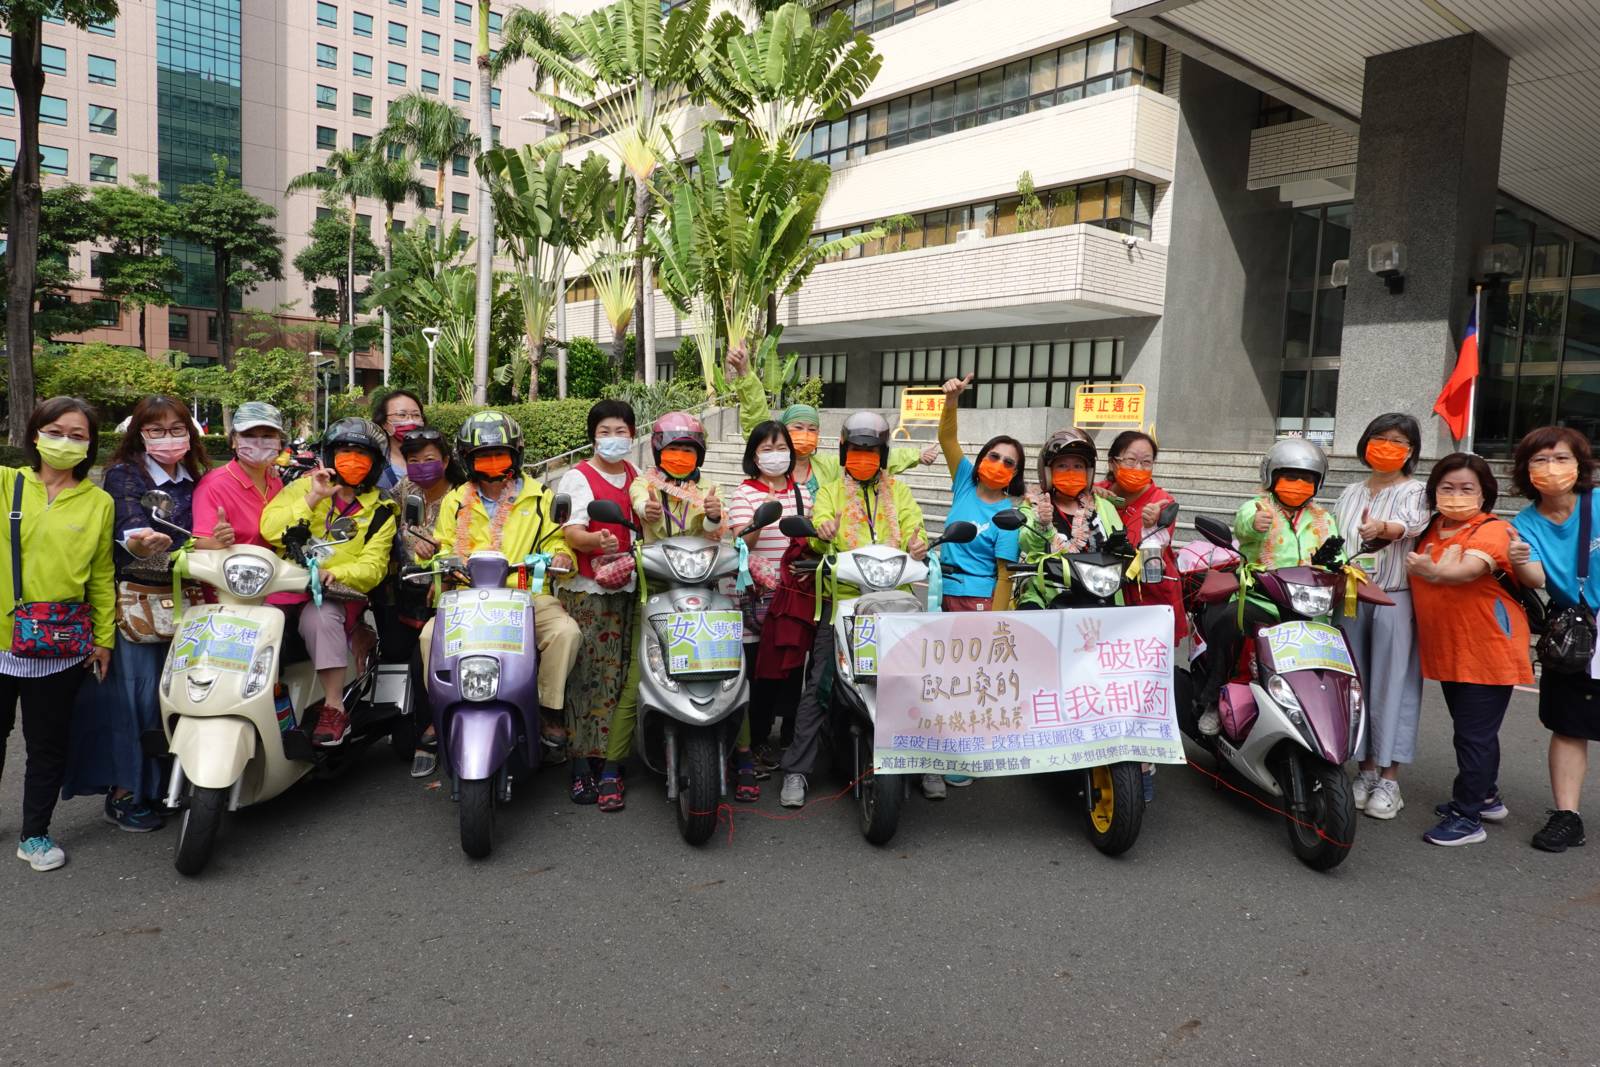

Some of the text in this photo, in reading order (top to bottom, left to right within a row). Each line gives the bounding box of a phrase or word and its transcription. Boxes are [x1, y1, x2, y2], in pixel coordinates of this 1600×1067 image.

[1082, 397, 1140, 413] 禁止通行
[176, 614, 258, 648] 女人夢想
[446, 601, 524, 634] 女人夢想
[667, 612, 742, 647] 女人夢想
[855, 619, 877, 648] 女
[920, 621, 1019, 668] 1000歲
[1096, 636, 1169, 671] 破除
[920, 666, 1021, 708] 歐巴桑的
[1032, 679, 1169, 725] 自我制約
[893, 719, 1172, 752] 突破自我框架 改寫自我圖像 我可以不一樣
